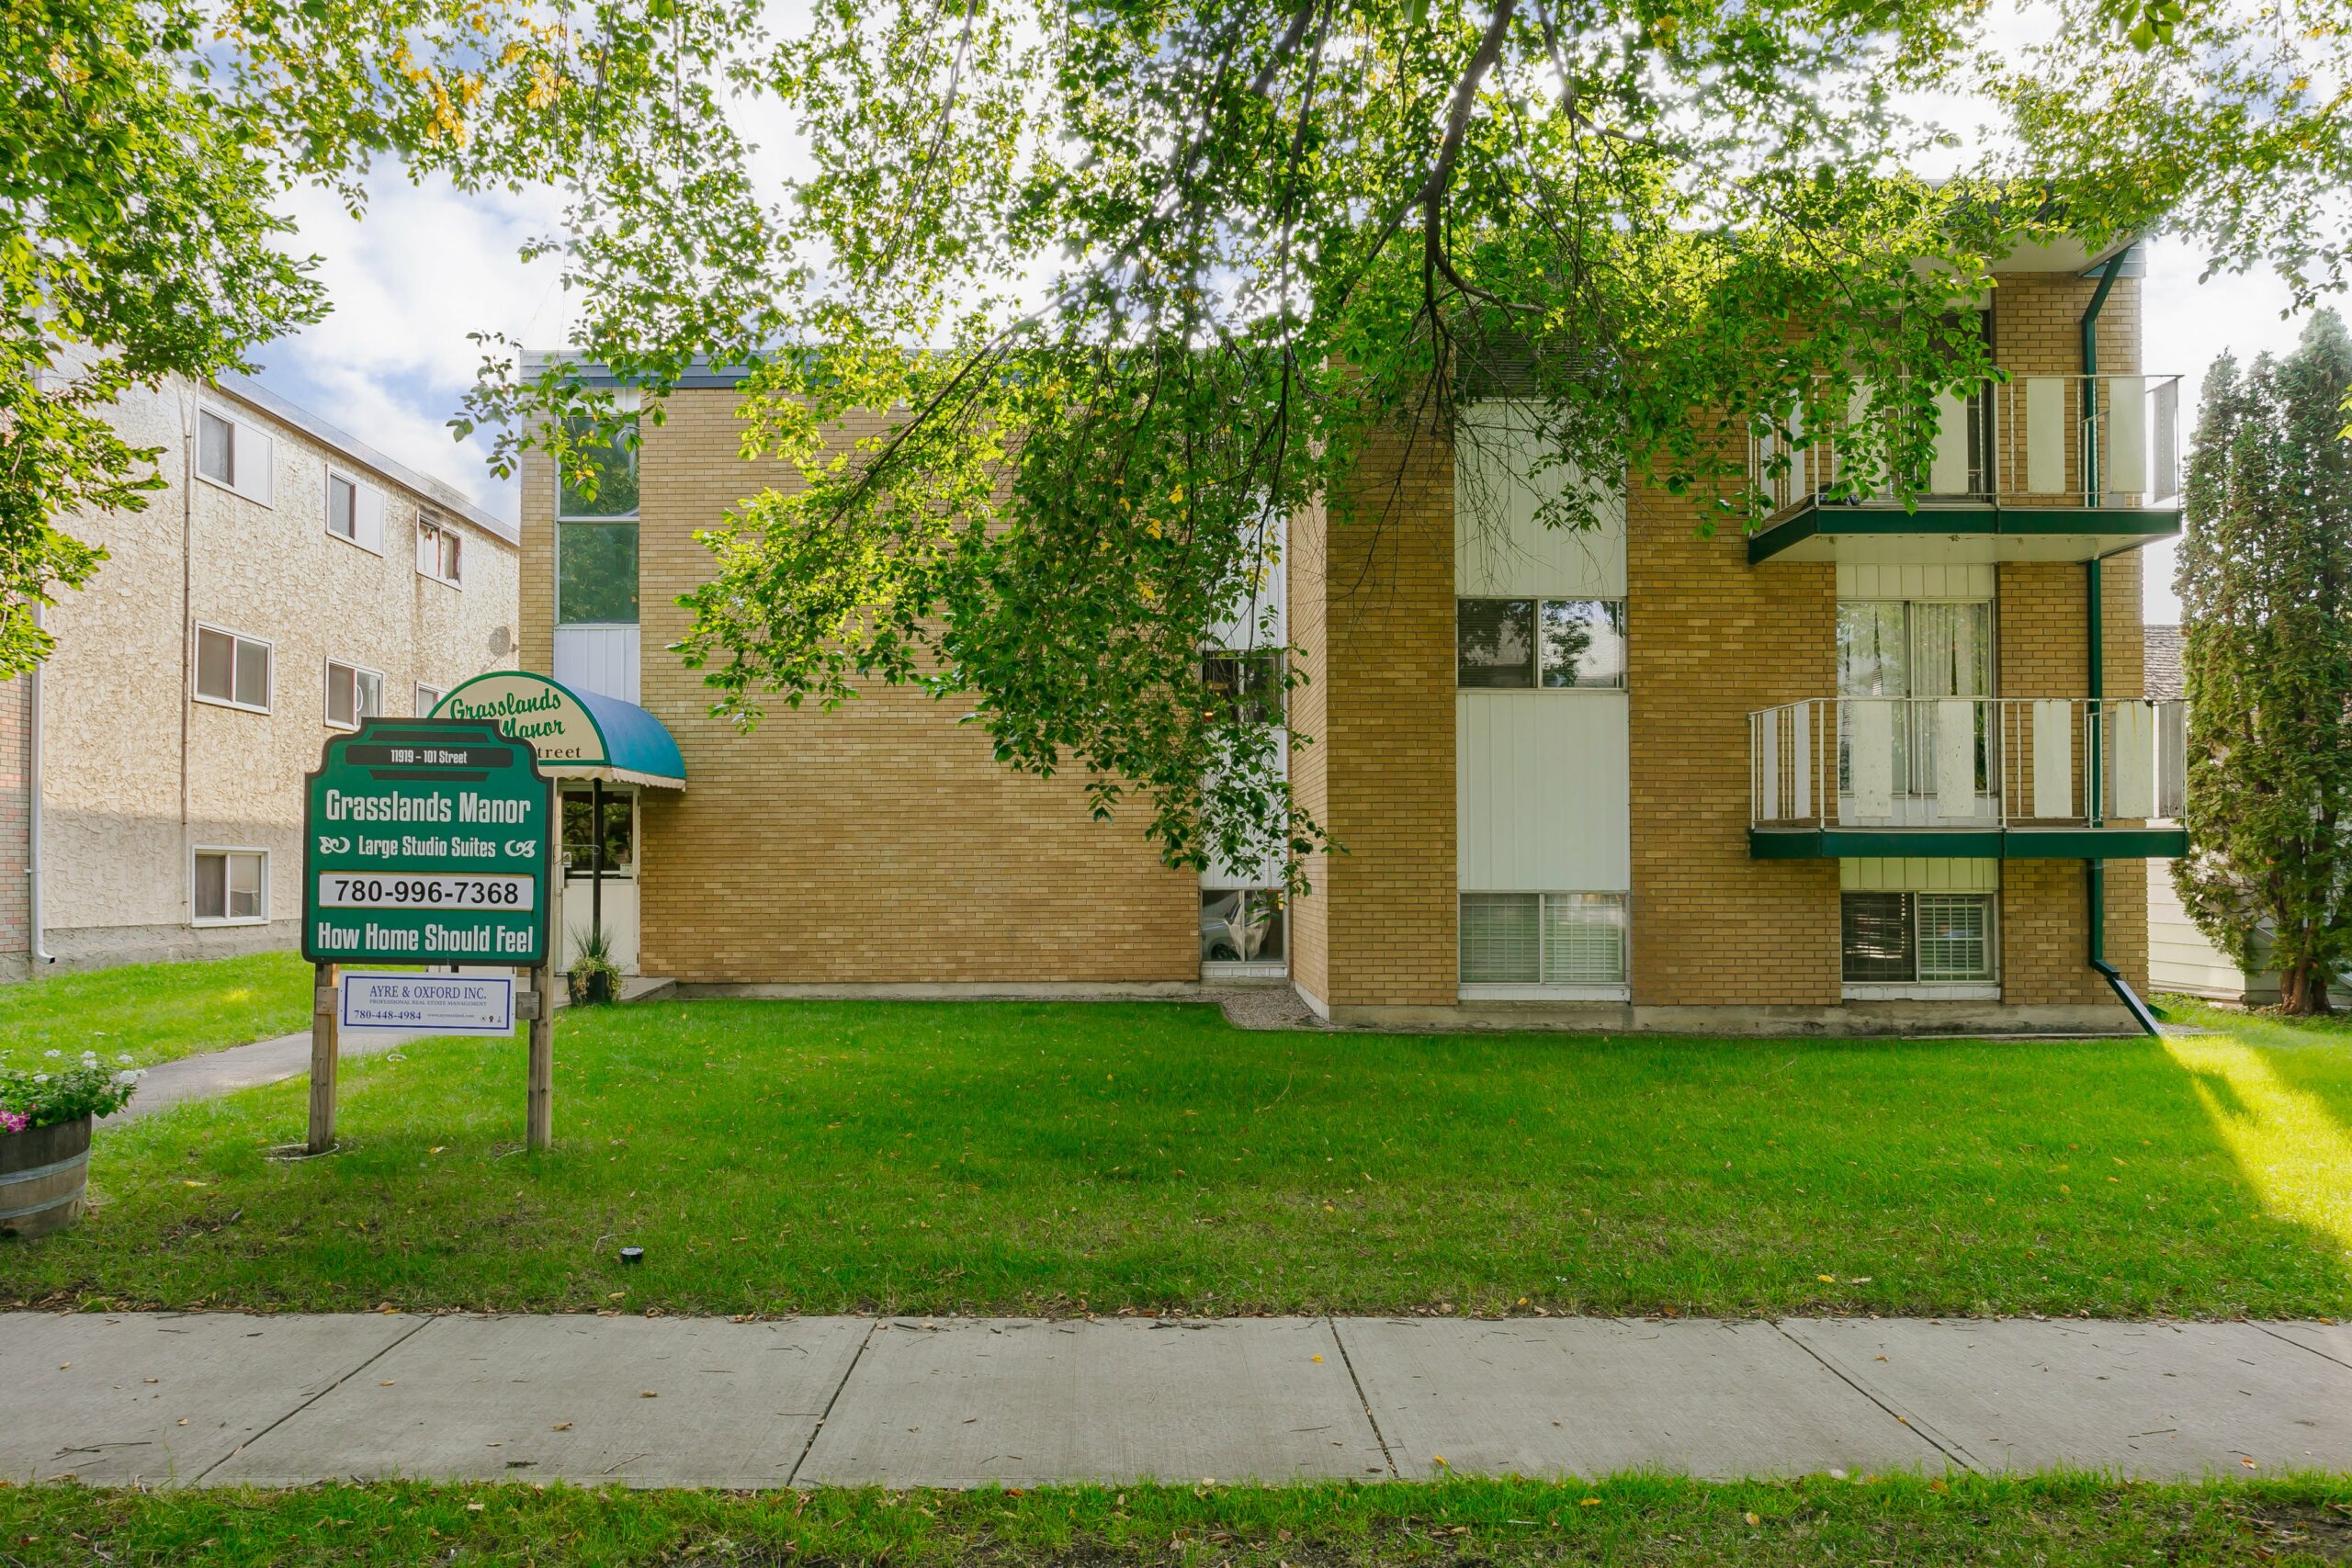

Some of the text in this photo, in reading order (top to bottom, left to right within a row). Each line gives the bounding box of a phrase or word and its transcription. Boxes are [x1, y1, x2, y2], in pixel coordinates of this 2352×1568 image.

[450, 688, 561, 719] Grasslands
[502, 717, 566, 739] Manor
[390, 750, 413, 762] 11919
[424, 750, 436, 763] 101
[438, 750, 468, 763] Street
[537, 746, 582, 758] treet
[326, 789, 531, 823] Grasslands Manor
[358, 835, 496, 859] Large Studio Suites
[335, 880, 519, 904] 780-996-7368
[318, 922, 534, 953] How Home Should Feel
[369, 986, 487, 999] AYRE & OXFORD INC.
[354, 1010, 422, 1021] 780-448-4984
